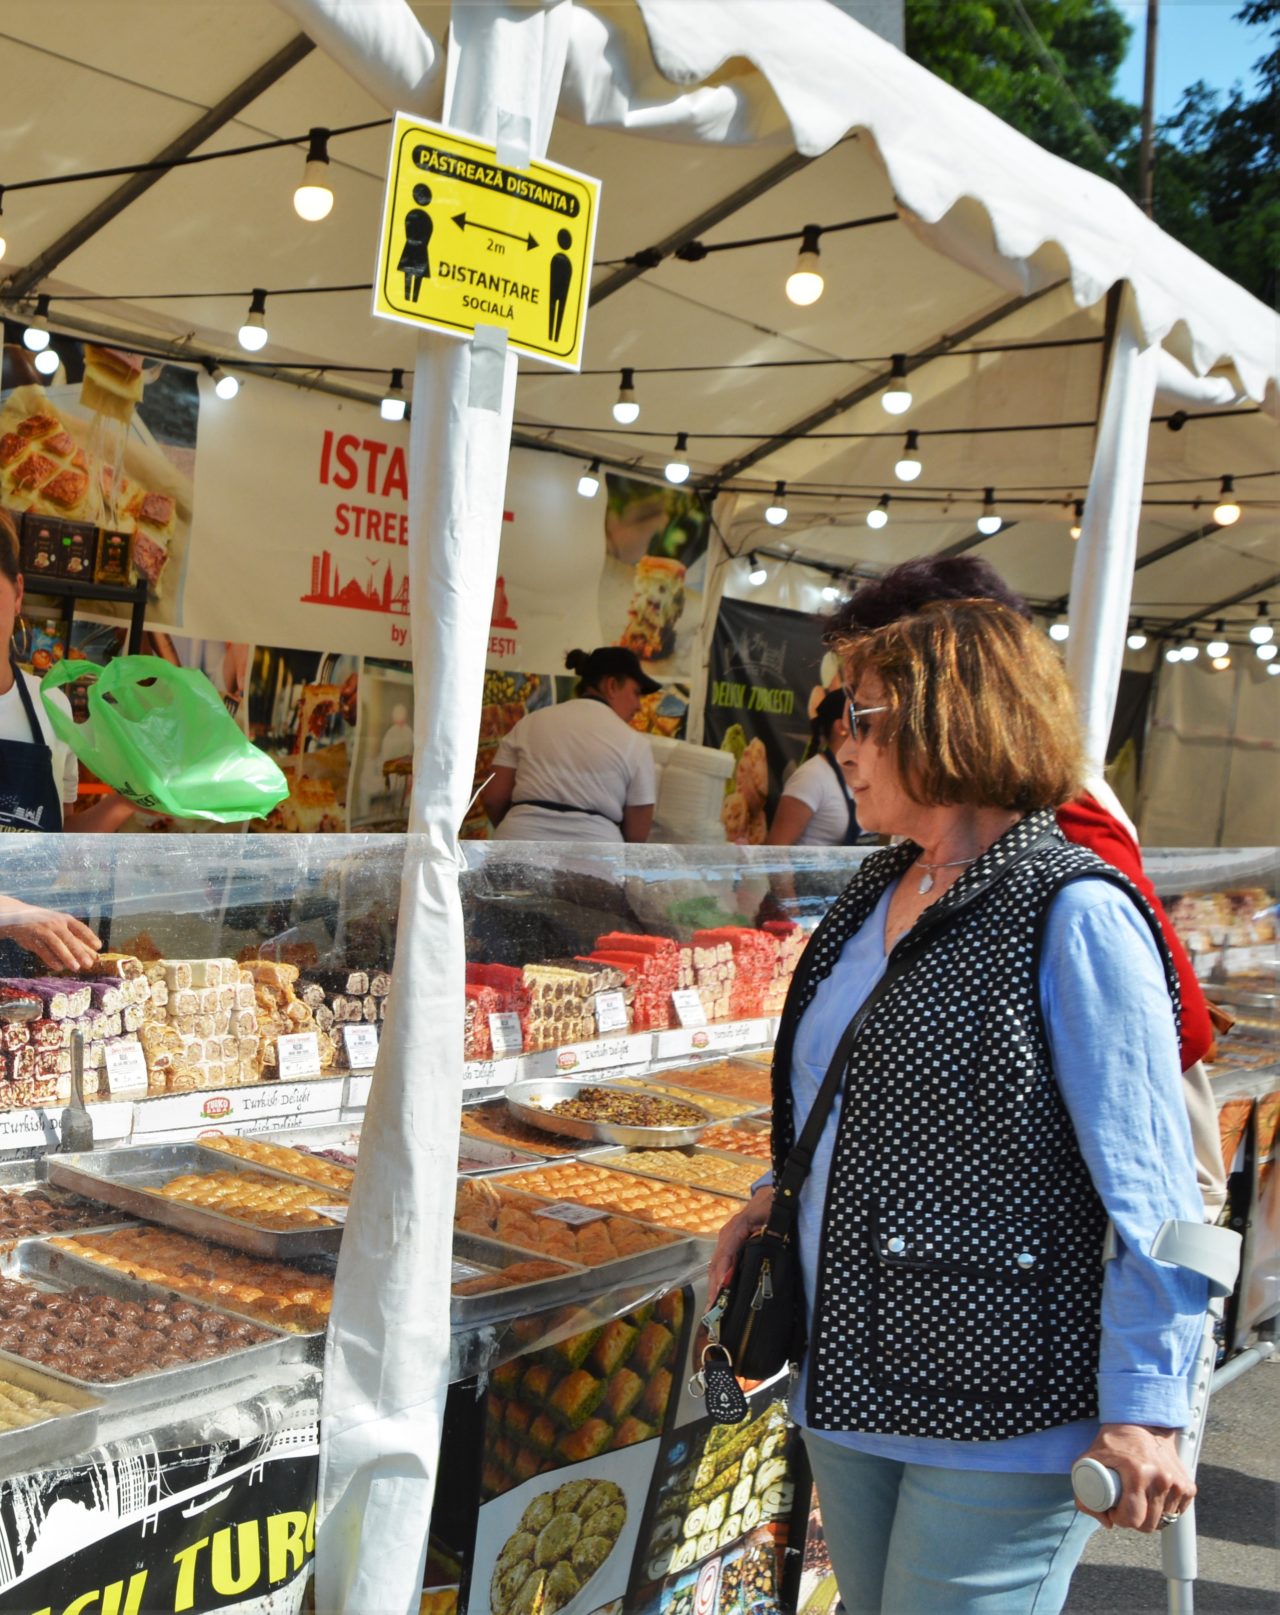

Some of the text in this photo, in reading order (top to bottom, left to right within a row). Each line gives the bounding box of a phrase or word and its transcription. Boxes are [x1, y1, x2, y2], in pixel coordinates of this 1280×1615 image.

[419, 148, 503, 189] PĂSTREAZĂ
[506, 176, 567, 211] DISTANȚA
[486, 238, 505, 256] 2m
[437, 260, 540, 304] DISTANȚARE
[462, 295, 515, 320] SOCIALĂ
[319, 430, 409, 501] ISTA
[334, 503, 409, 546] STREE
[391, 624, 408, 646] by
[0, 1113, 45, 1135] Turkish
